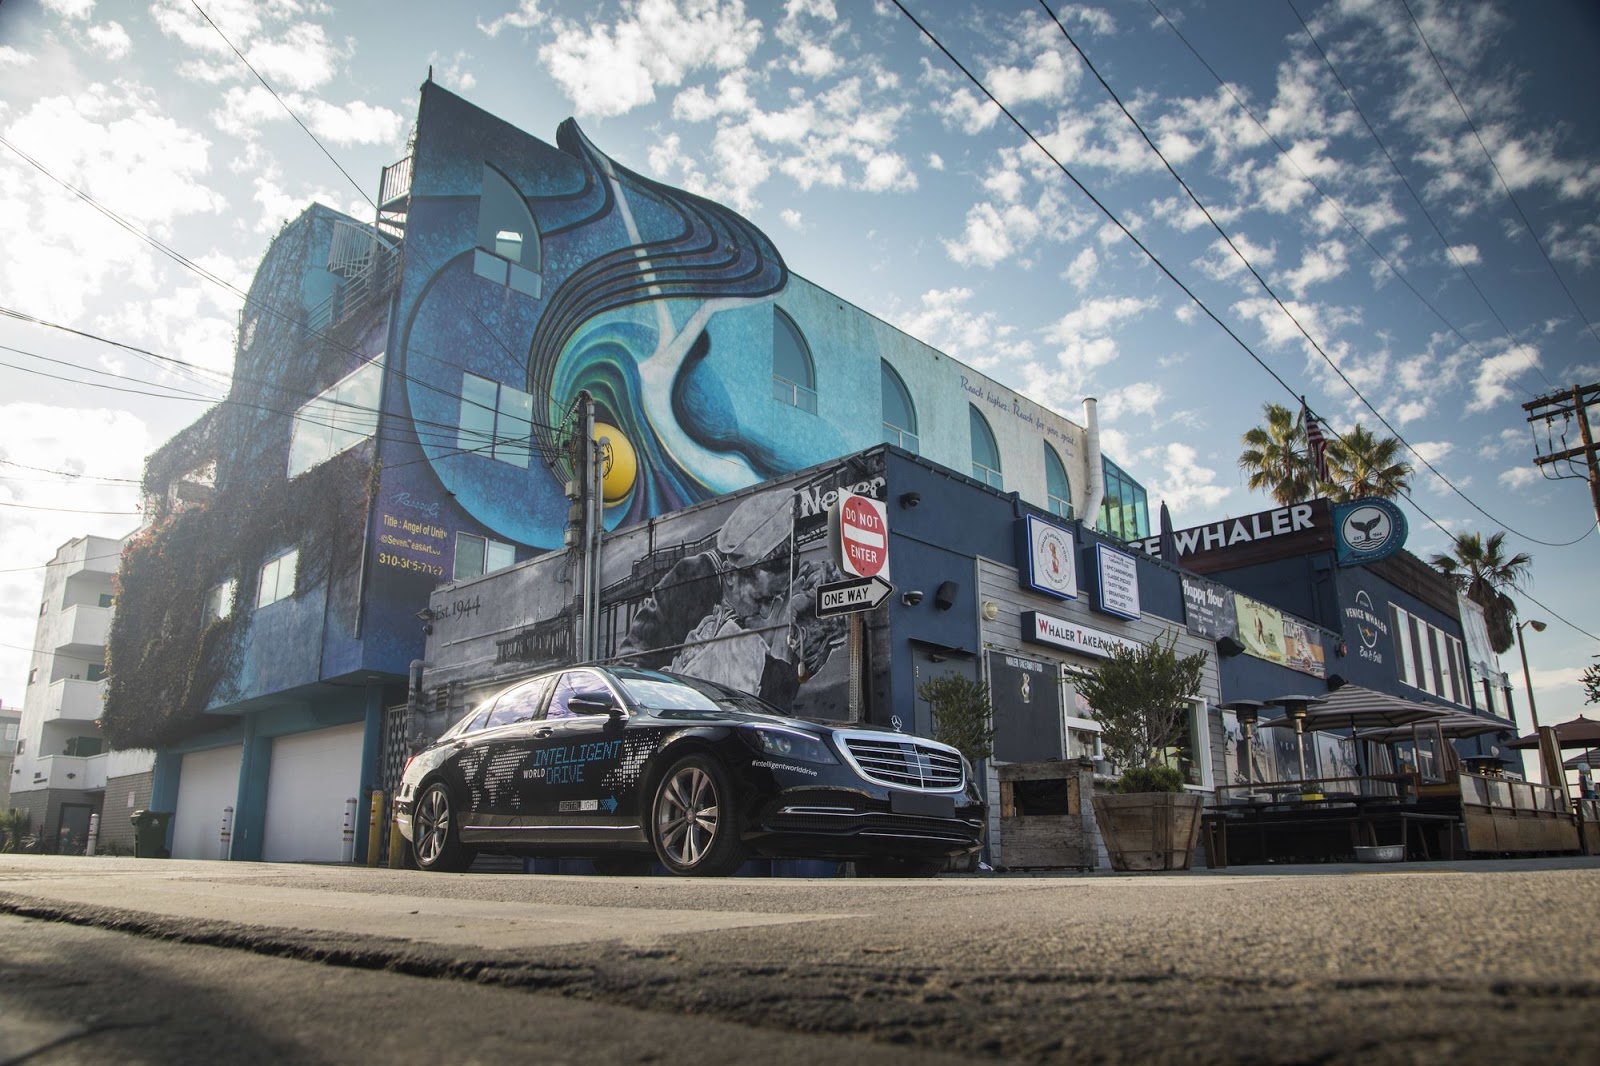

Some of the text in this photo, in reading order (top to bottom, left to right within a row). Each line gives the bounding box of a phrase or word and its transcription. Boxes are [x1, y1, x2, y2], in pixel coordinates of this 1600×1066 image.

[961, 375, 984, 398] Reach
[1013, 403, 1033, 423] Reach
[800, 477, 886, 518] Neer
[384, 515, 398, 527] Title
[403, 520, 422, 535] Angel
[422, 527, 430, 535] of
[846, 507, 879, 529] DO NOT
[1174, 504, 1315, 556] WHALER
[851, 544, 877, 563] ENTER
[824, 587, 868, 606] ONE WAY
[1182, 579, 1224, 608] Happy Hour
[436, 595, 480, 621] Est. 1944
[1038, 619, 1075, 642] WHALER
[1345, 608, 1364, 619] VENICE
[1364, 612, 1388, 635] WHALER
[533, 740, 622, 767] INTELLIGENT
[523, 764, 585, 784] WORLD DRIVE
[752, 760, 818, 776] #intelligentworlddrive
